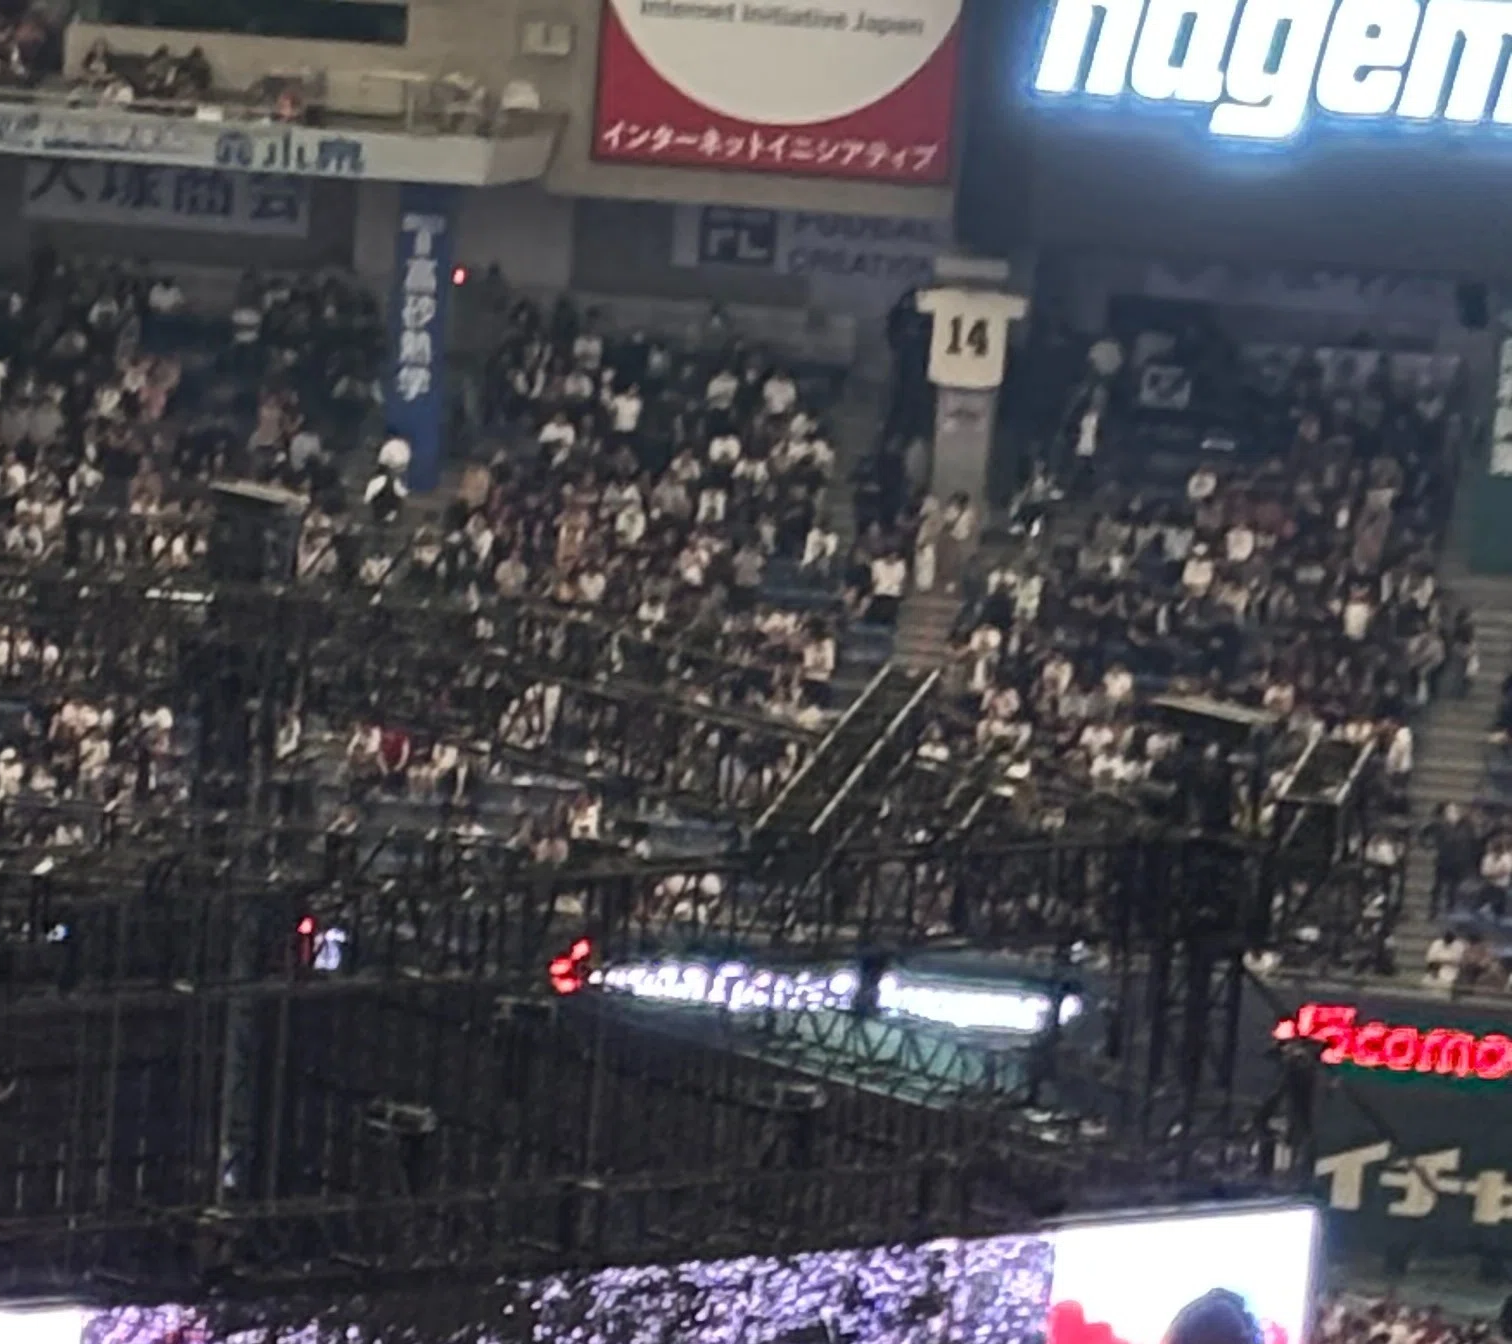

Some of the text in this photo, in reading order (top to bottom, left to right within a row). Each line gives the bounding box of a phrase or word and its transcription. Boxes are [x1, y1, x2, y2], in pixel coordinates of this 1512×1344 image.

[742, 4, 848, 31] Initiative
[852, 11, 925, 37] Japan
[945, 313, 989, 357] 14
